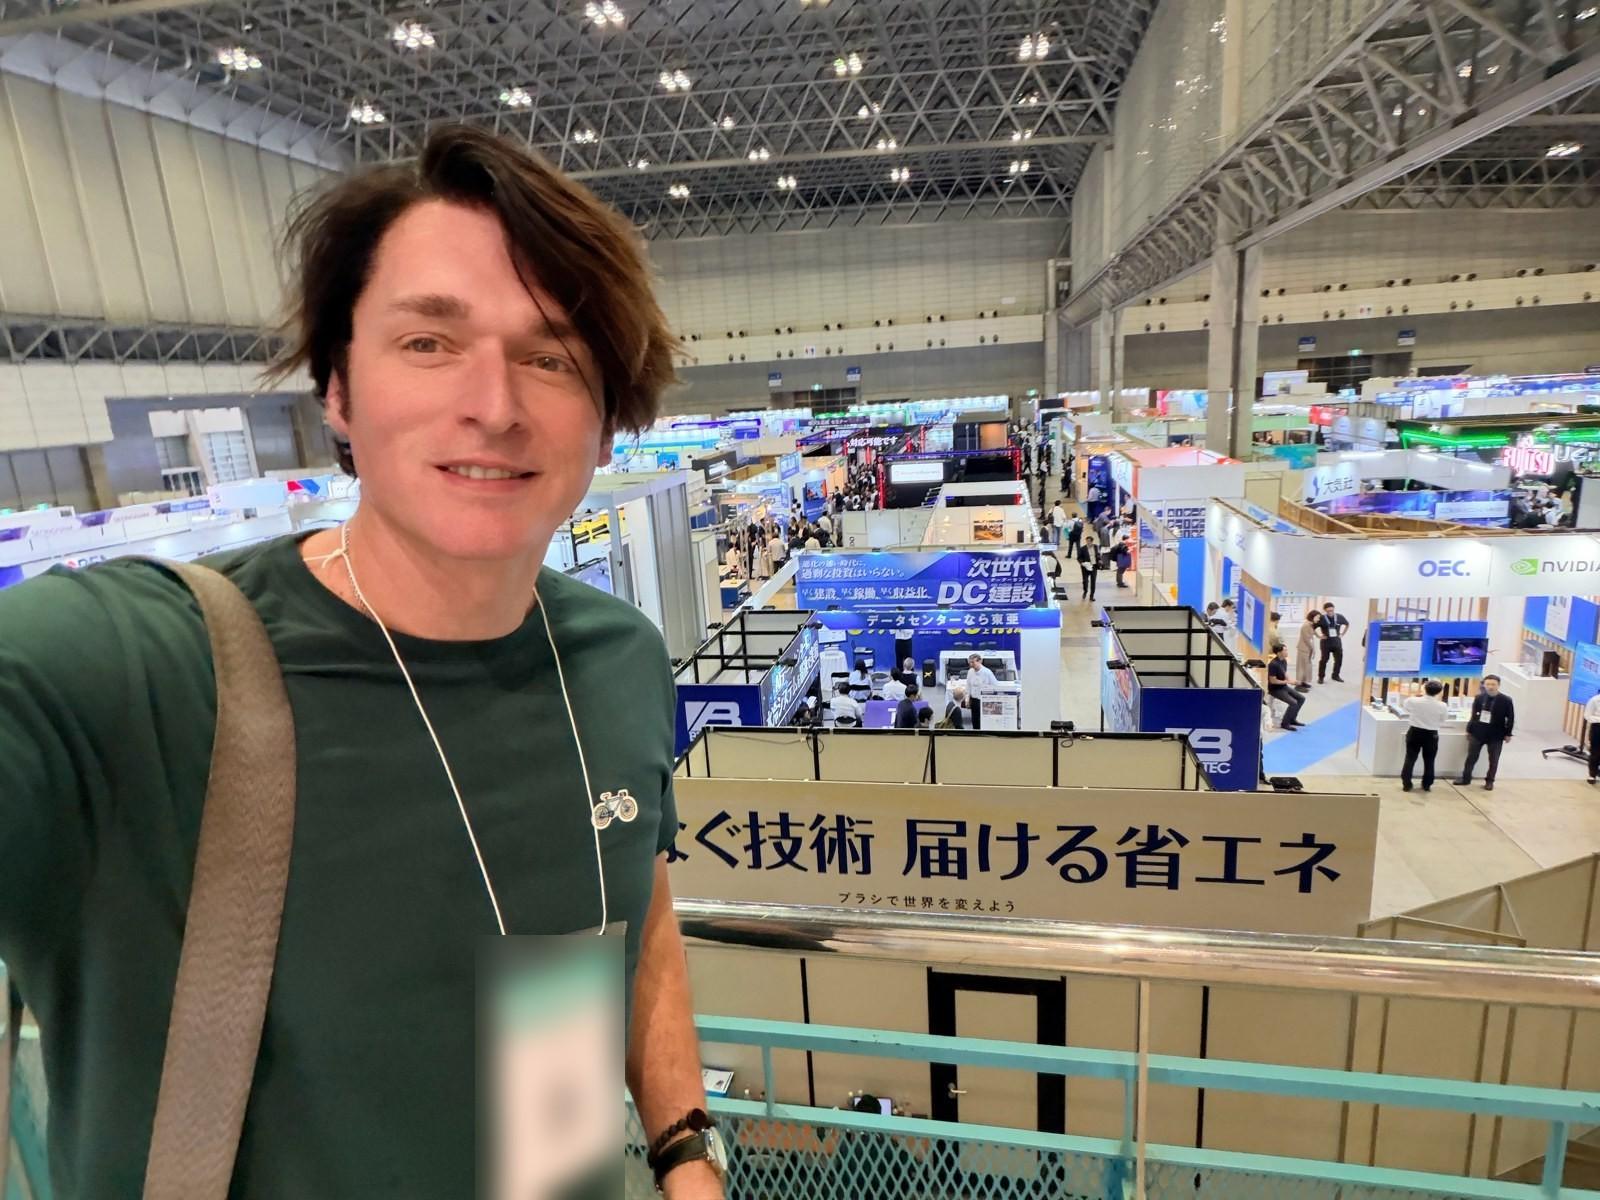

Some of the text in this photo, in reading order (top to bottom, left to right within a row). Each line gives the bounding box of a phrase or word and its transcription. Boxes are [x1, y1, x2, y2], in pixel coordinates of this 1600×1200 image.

[967, 556, 1037, 577] 次世代
[867, 612, 1020, 627] データセンターなら東亜
[901, 818, 1341, 893] 届ける省エネ
[838, 892, 1015, 913] ブラシで世界を変えよう
